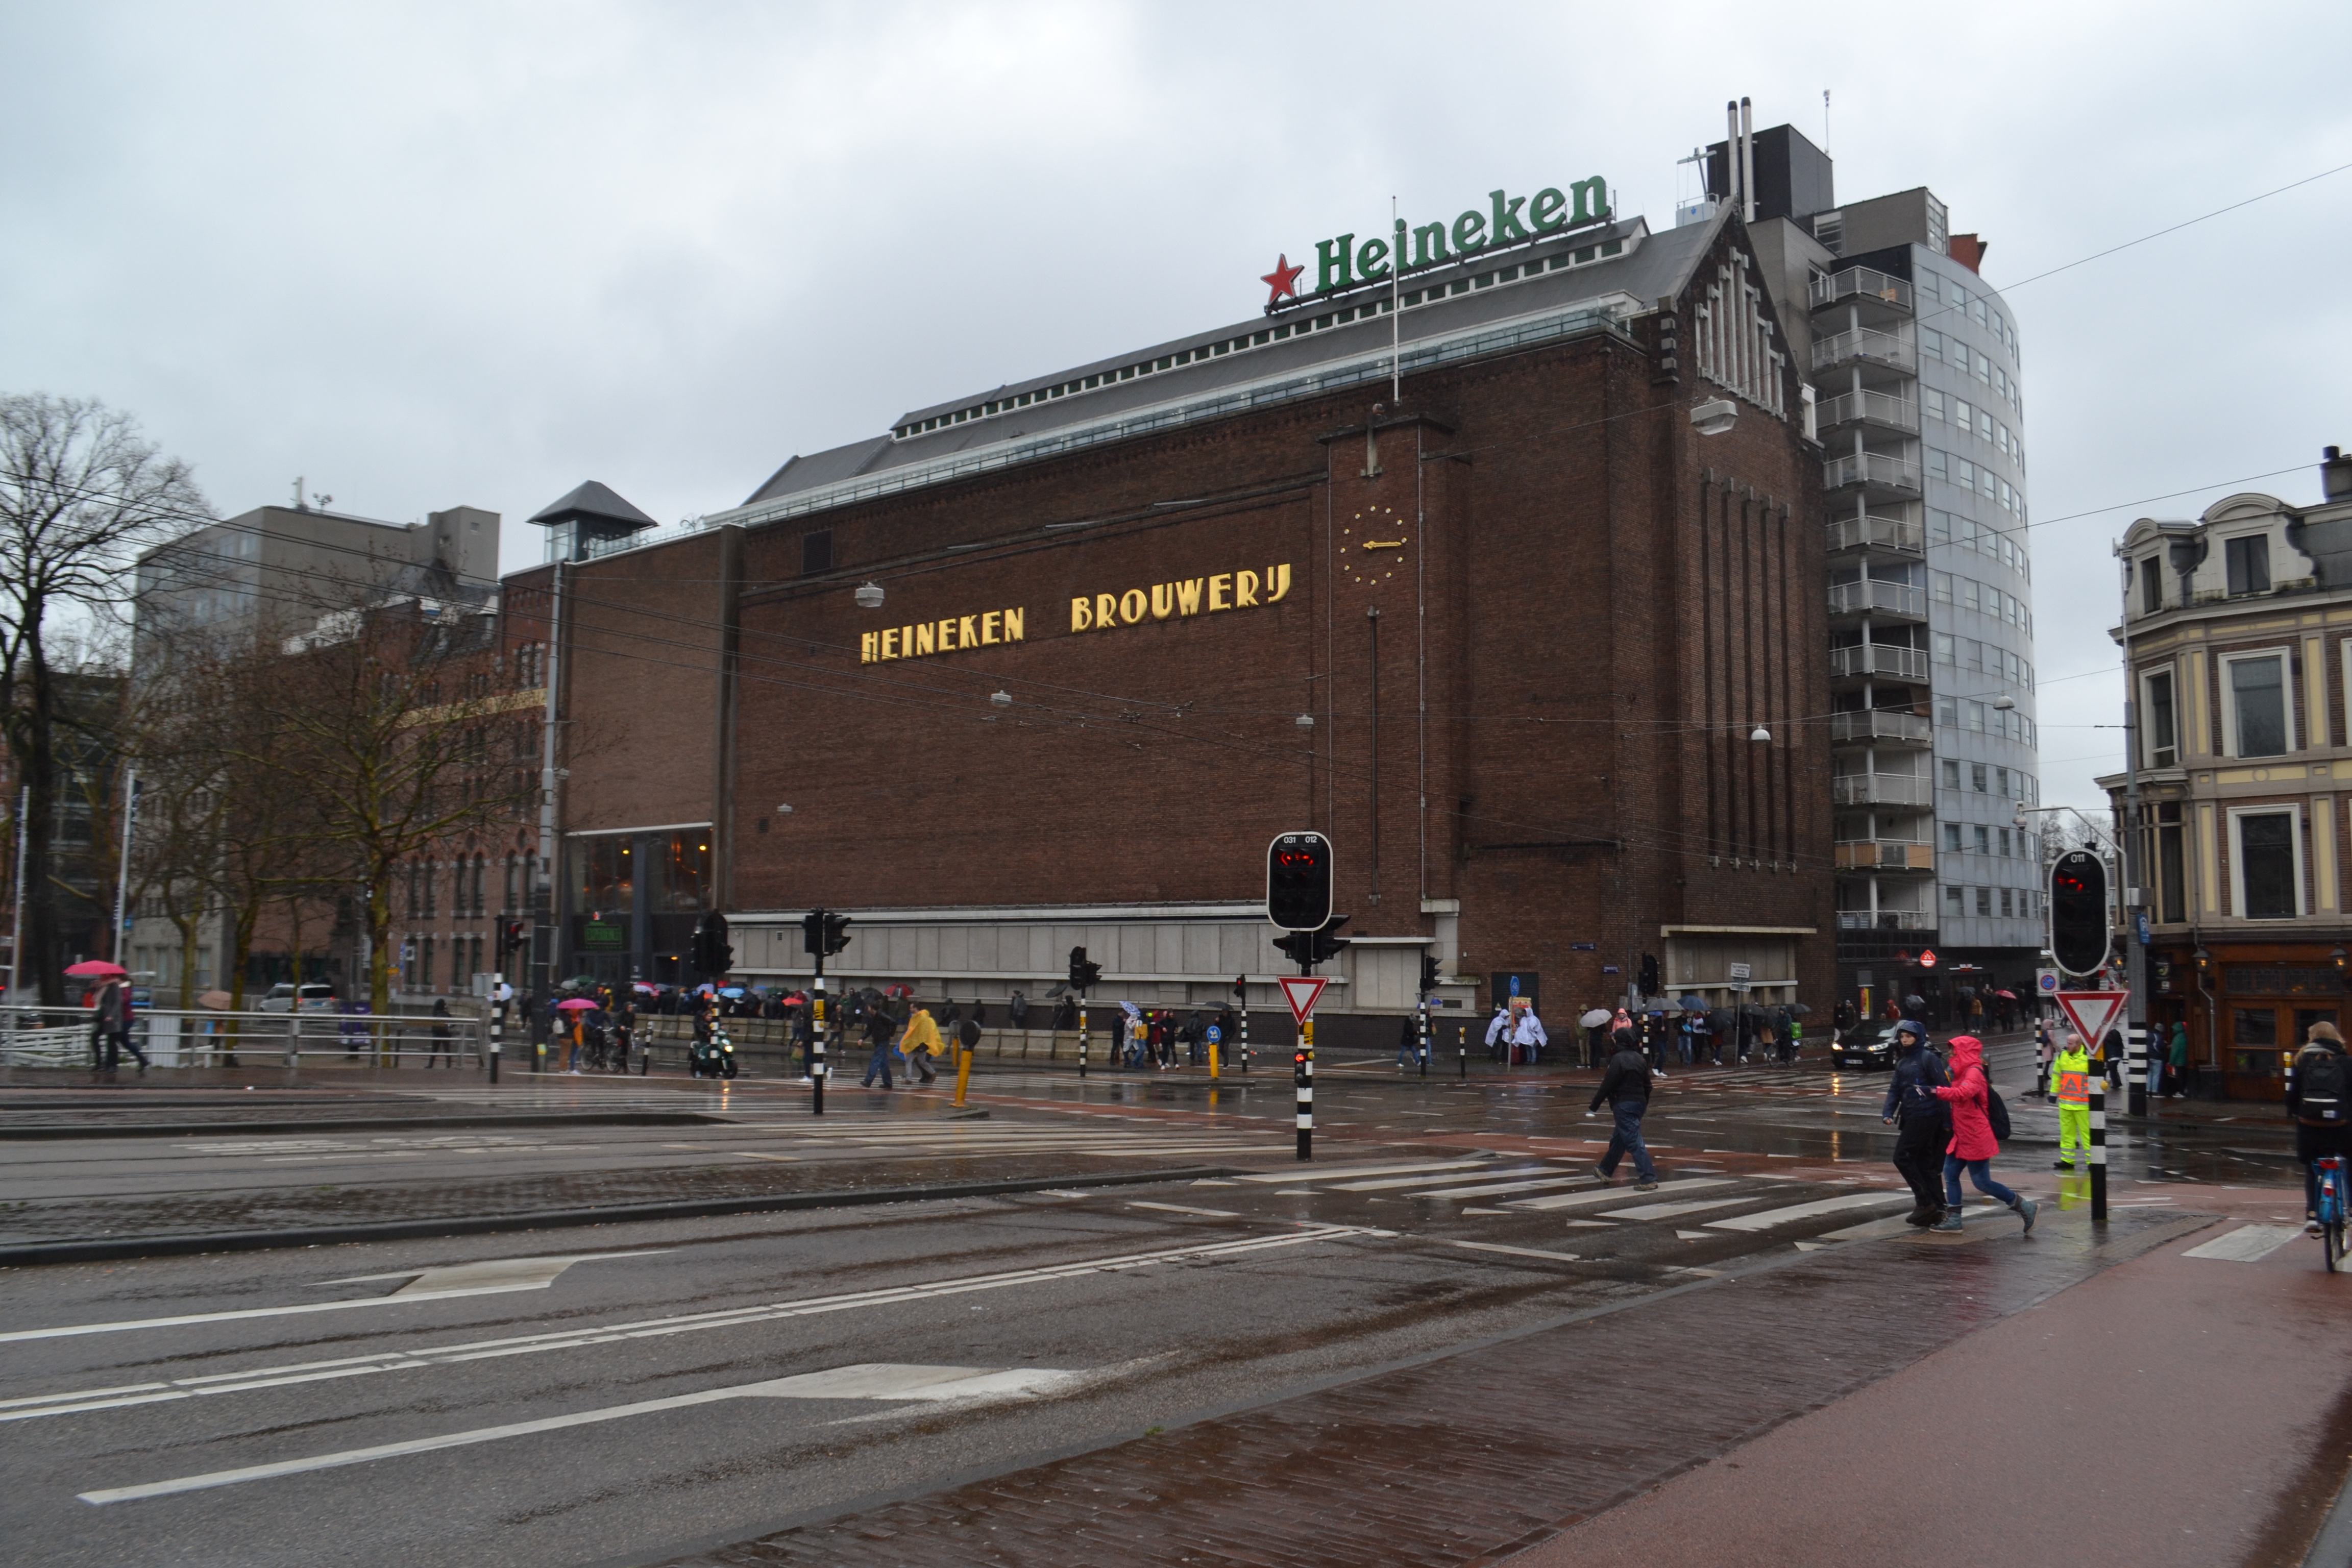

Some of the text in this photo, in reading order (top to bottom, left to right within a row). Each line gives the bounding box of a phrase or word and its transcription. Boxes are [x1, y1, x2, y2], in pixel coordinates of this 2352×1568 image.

[1315, 175, 1612, 293] Heineken
[861, 563, 1291, 665] HEINEKEN BROUWERIJ
[2070, 853, 2085, 863] 011
